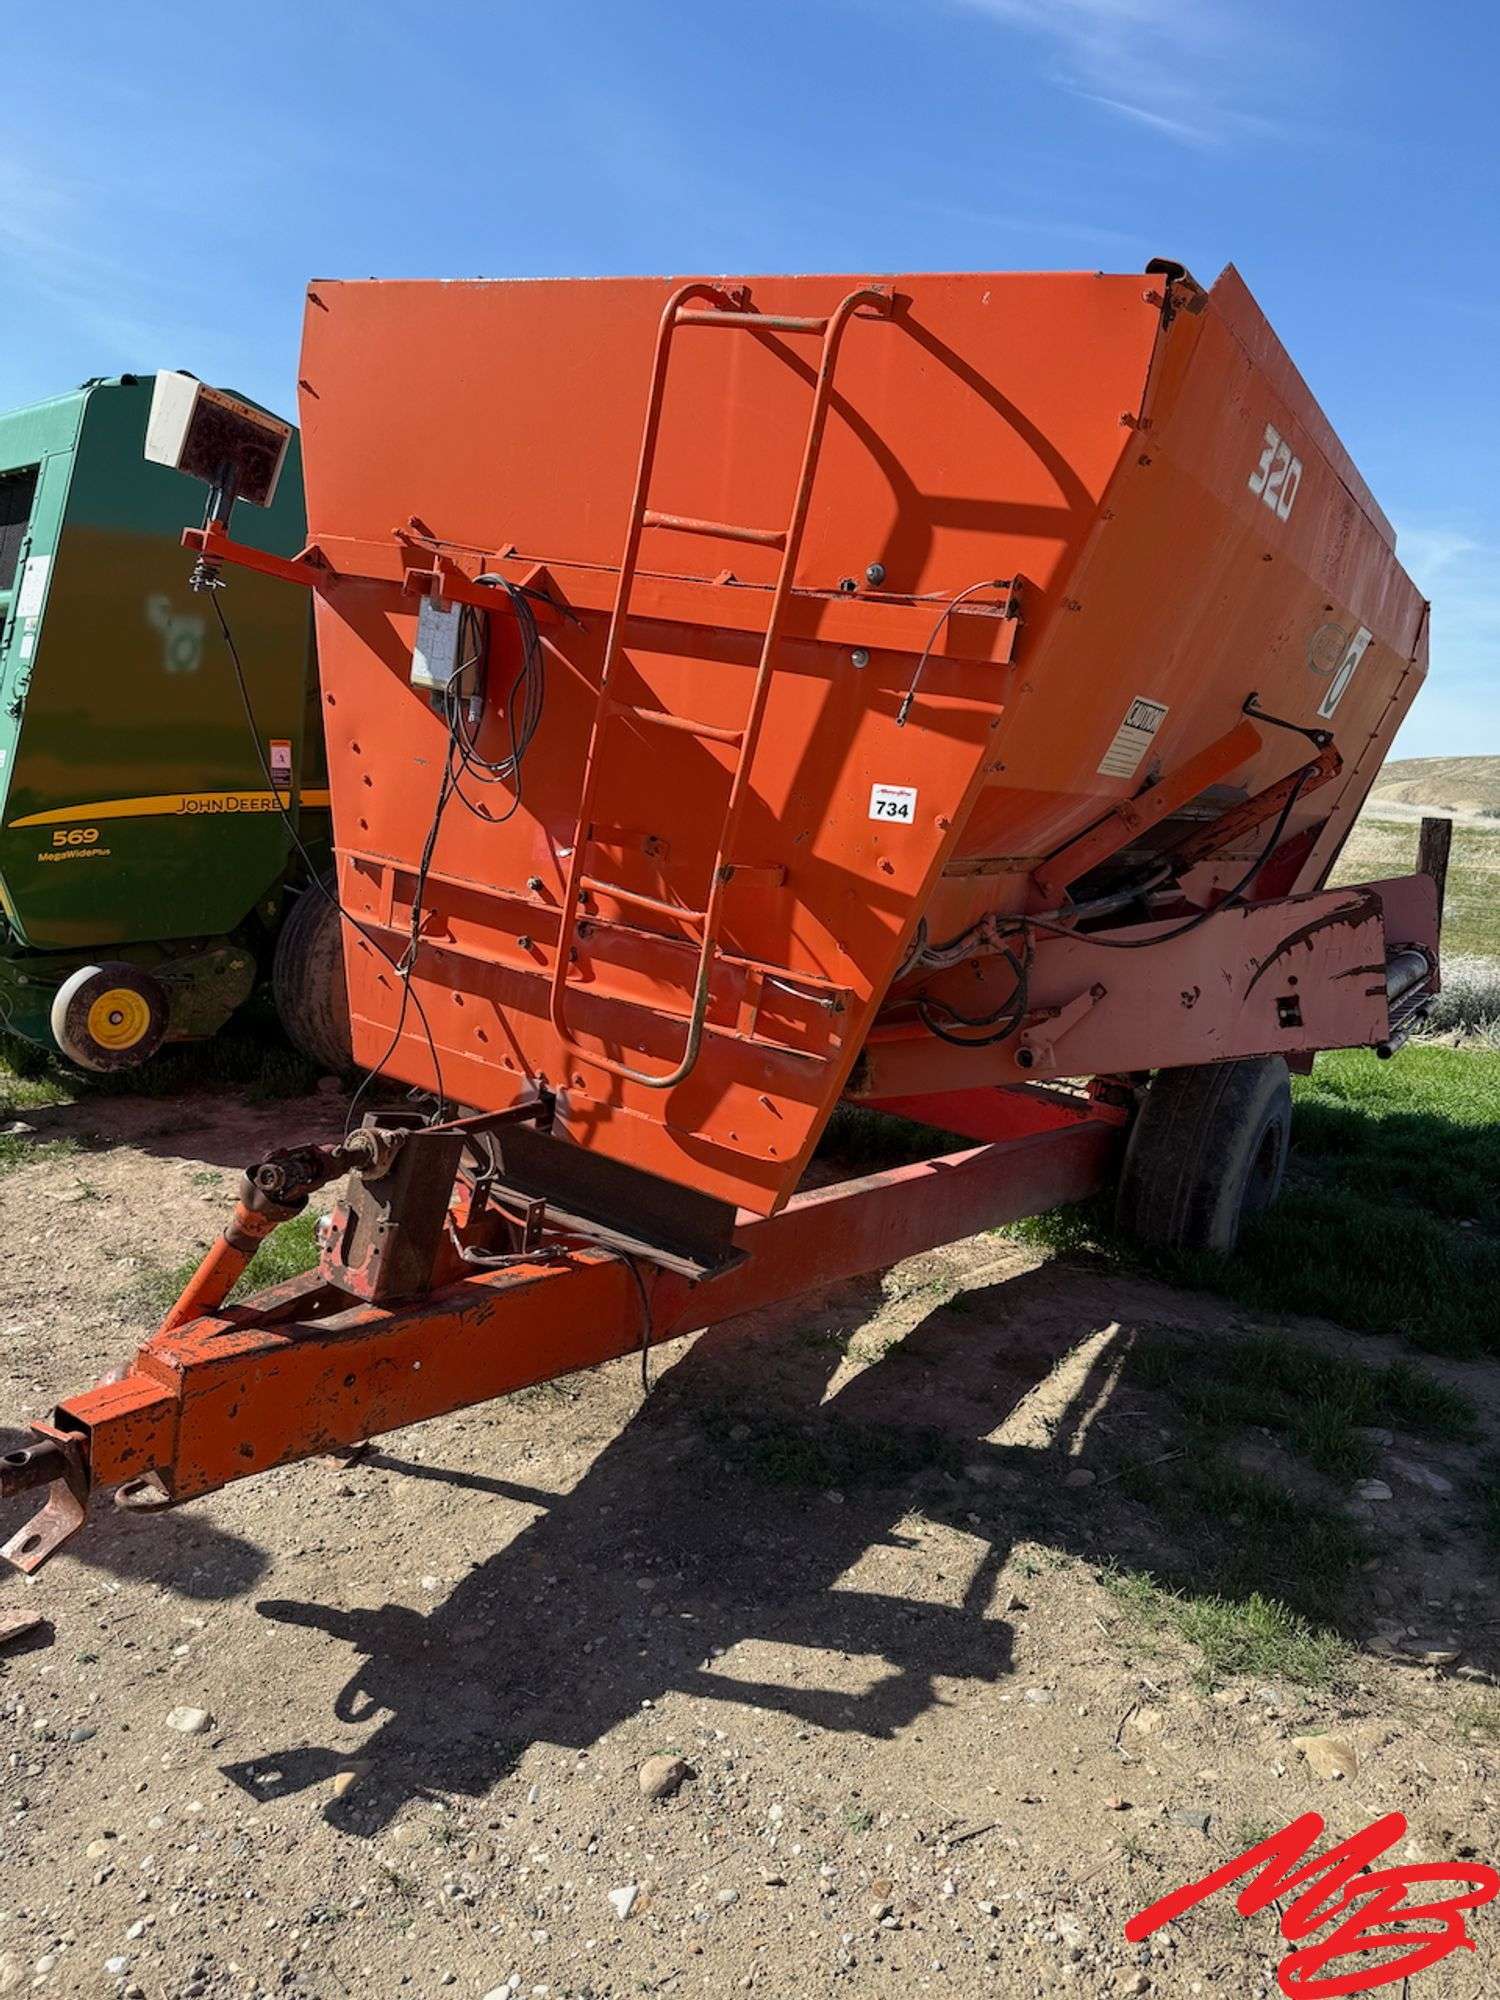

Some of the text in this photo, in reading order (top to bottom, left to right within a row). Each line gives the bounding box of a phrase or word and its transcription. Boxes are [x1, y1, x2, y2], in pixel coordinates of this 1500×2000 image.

[1248, 422, 1303, 522] 320
[176, 796, 282, 812] JOHN DEERE
[875, 800, 909, 818] 734
[52, 828, 100, 847] 569
